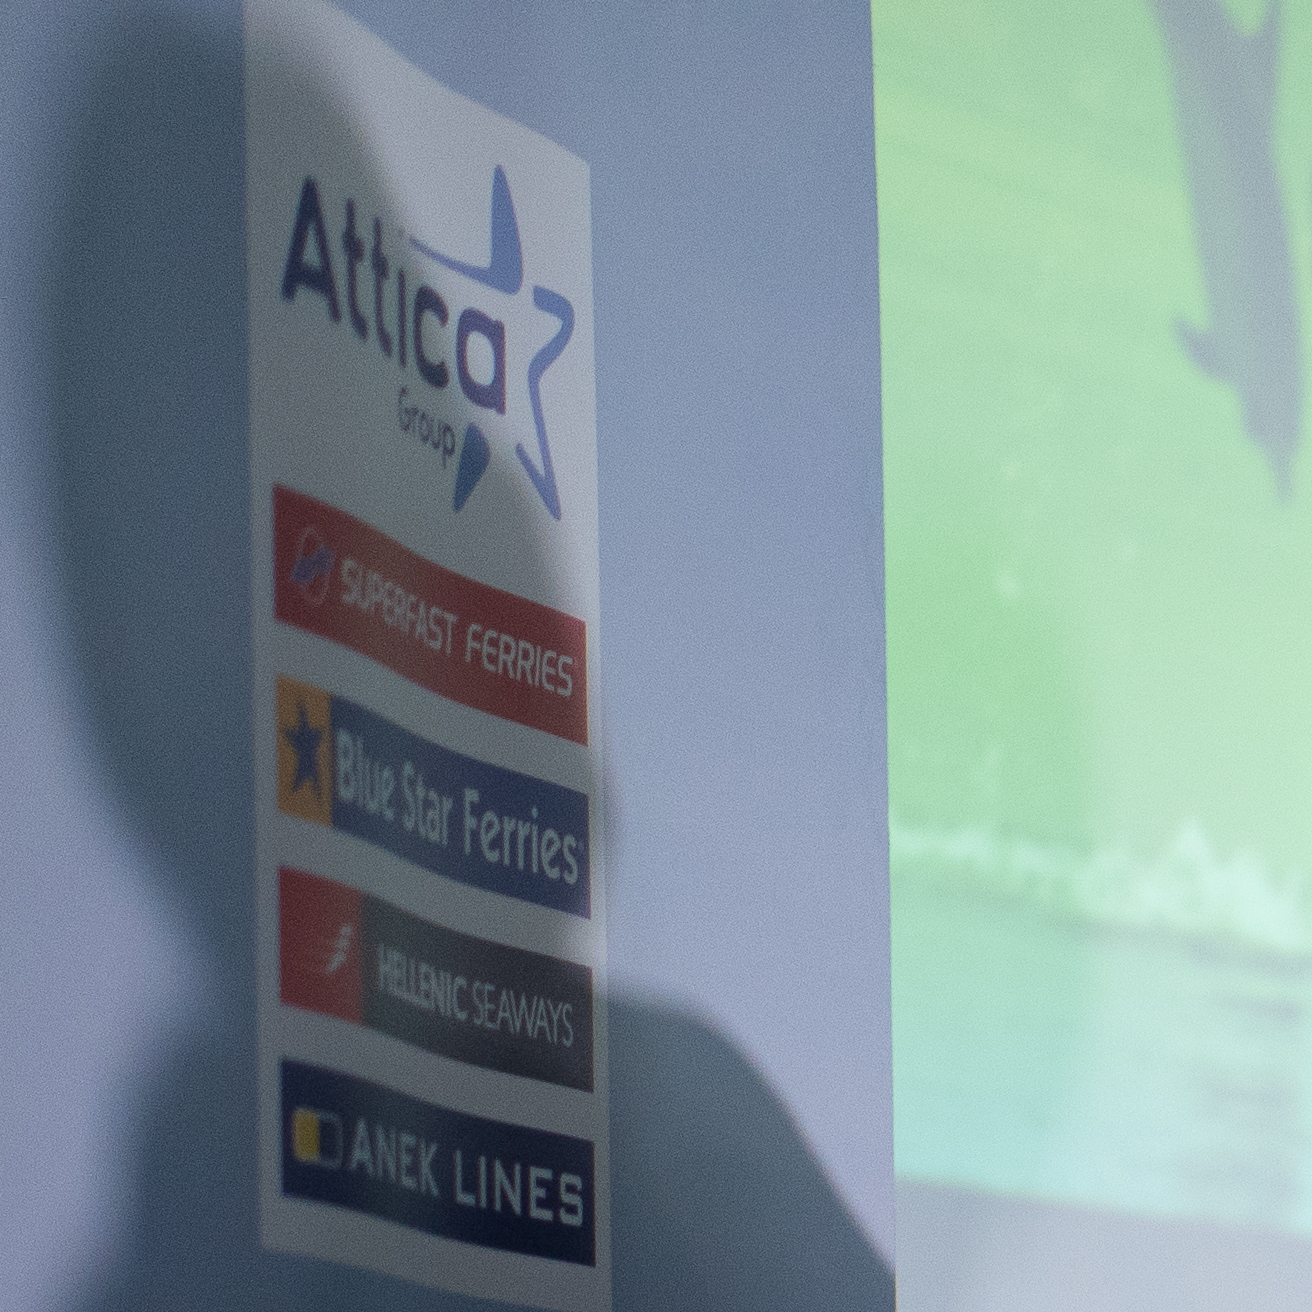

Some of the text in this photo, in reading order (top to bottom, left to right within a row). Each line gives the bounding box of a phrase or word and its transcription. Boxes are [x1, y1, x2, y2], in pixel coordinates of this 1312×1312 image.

[281, 175, 507, 416] Attica
[397, 386, 457, 468] Group
[340, 558, 575, 699] SUPERFAST FERRIES
[336, 728, 580, 886] Blue Star Ferries
[378, 942, 574, 1048] HELLENIC SEAWAYS
[348, 1119, 584, 1228] ANEK LINES
